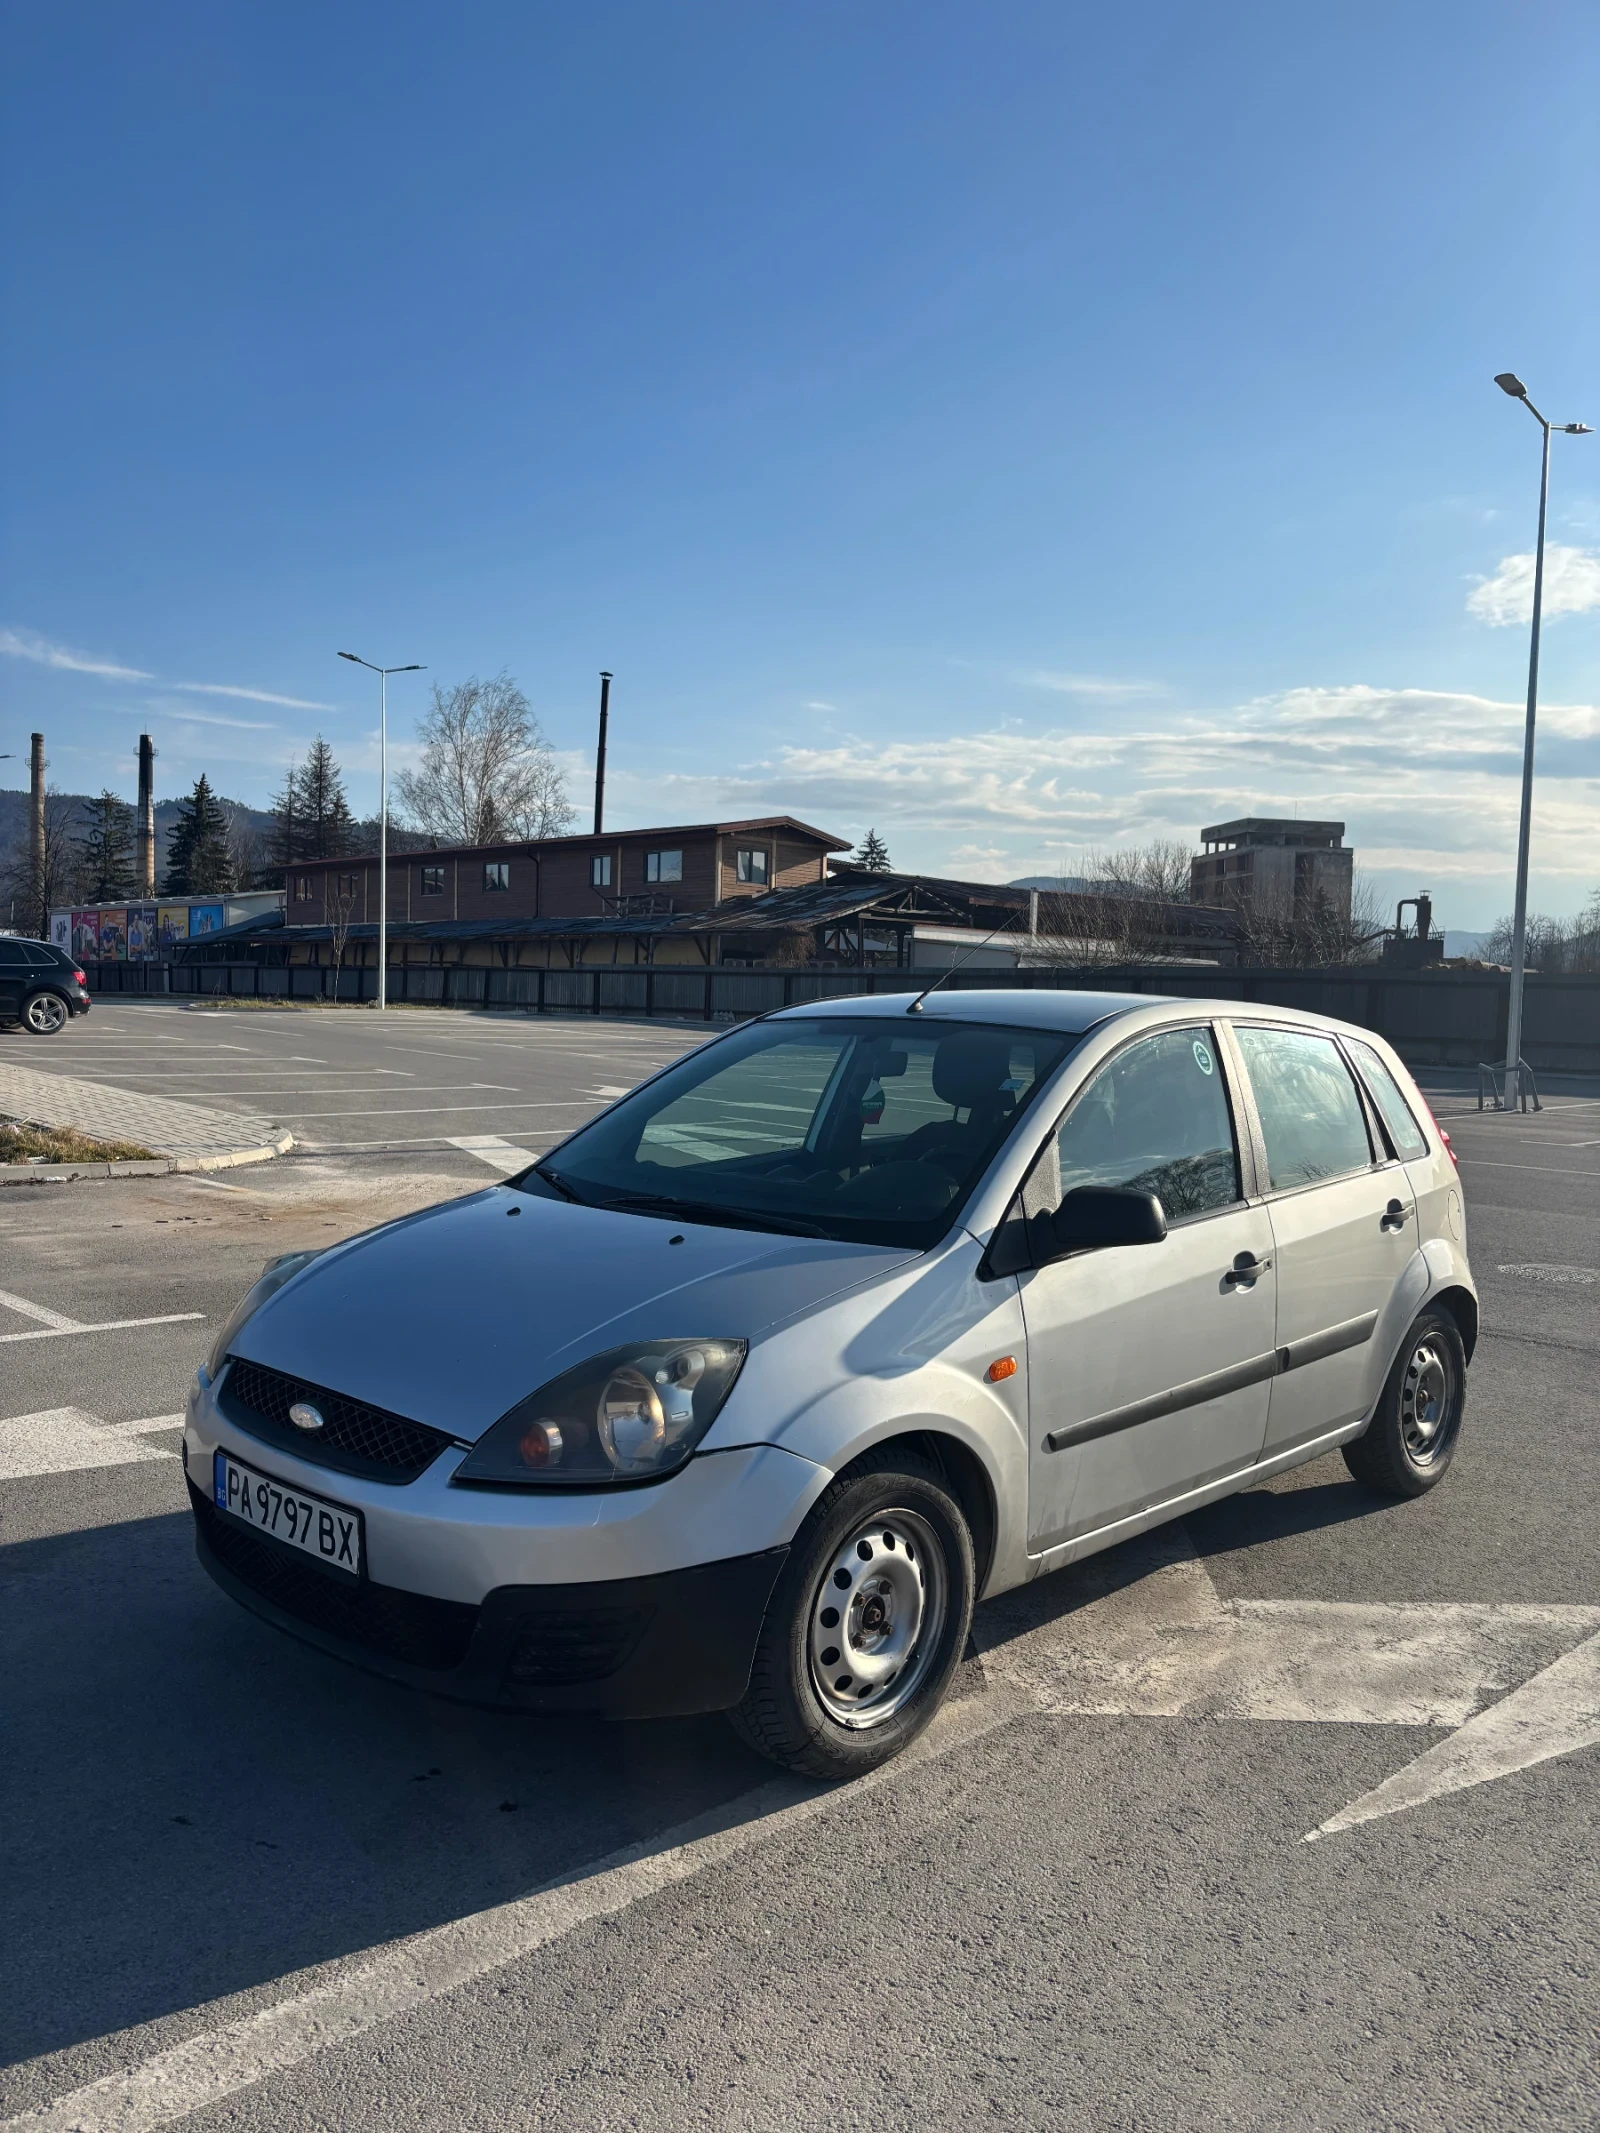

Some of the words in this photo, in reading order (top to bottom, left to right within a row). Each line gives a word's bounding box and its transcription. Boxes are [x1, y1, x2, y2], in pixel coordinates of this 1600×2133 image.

[217, 1487, 226, 1501] BG
[228, 1467, 253, 1519] PA
[256, 1482, 313, 1544] 9797
[318, 1509, 353, 1565] BX
